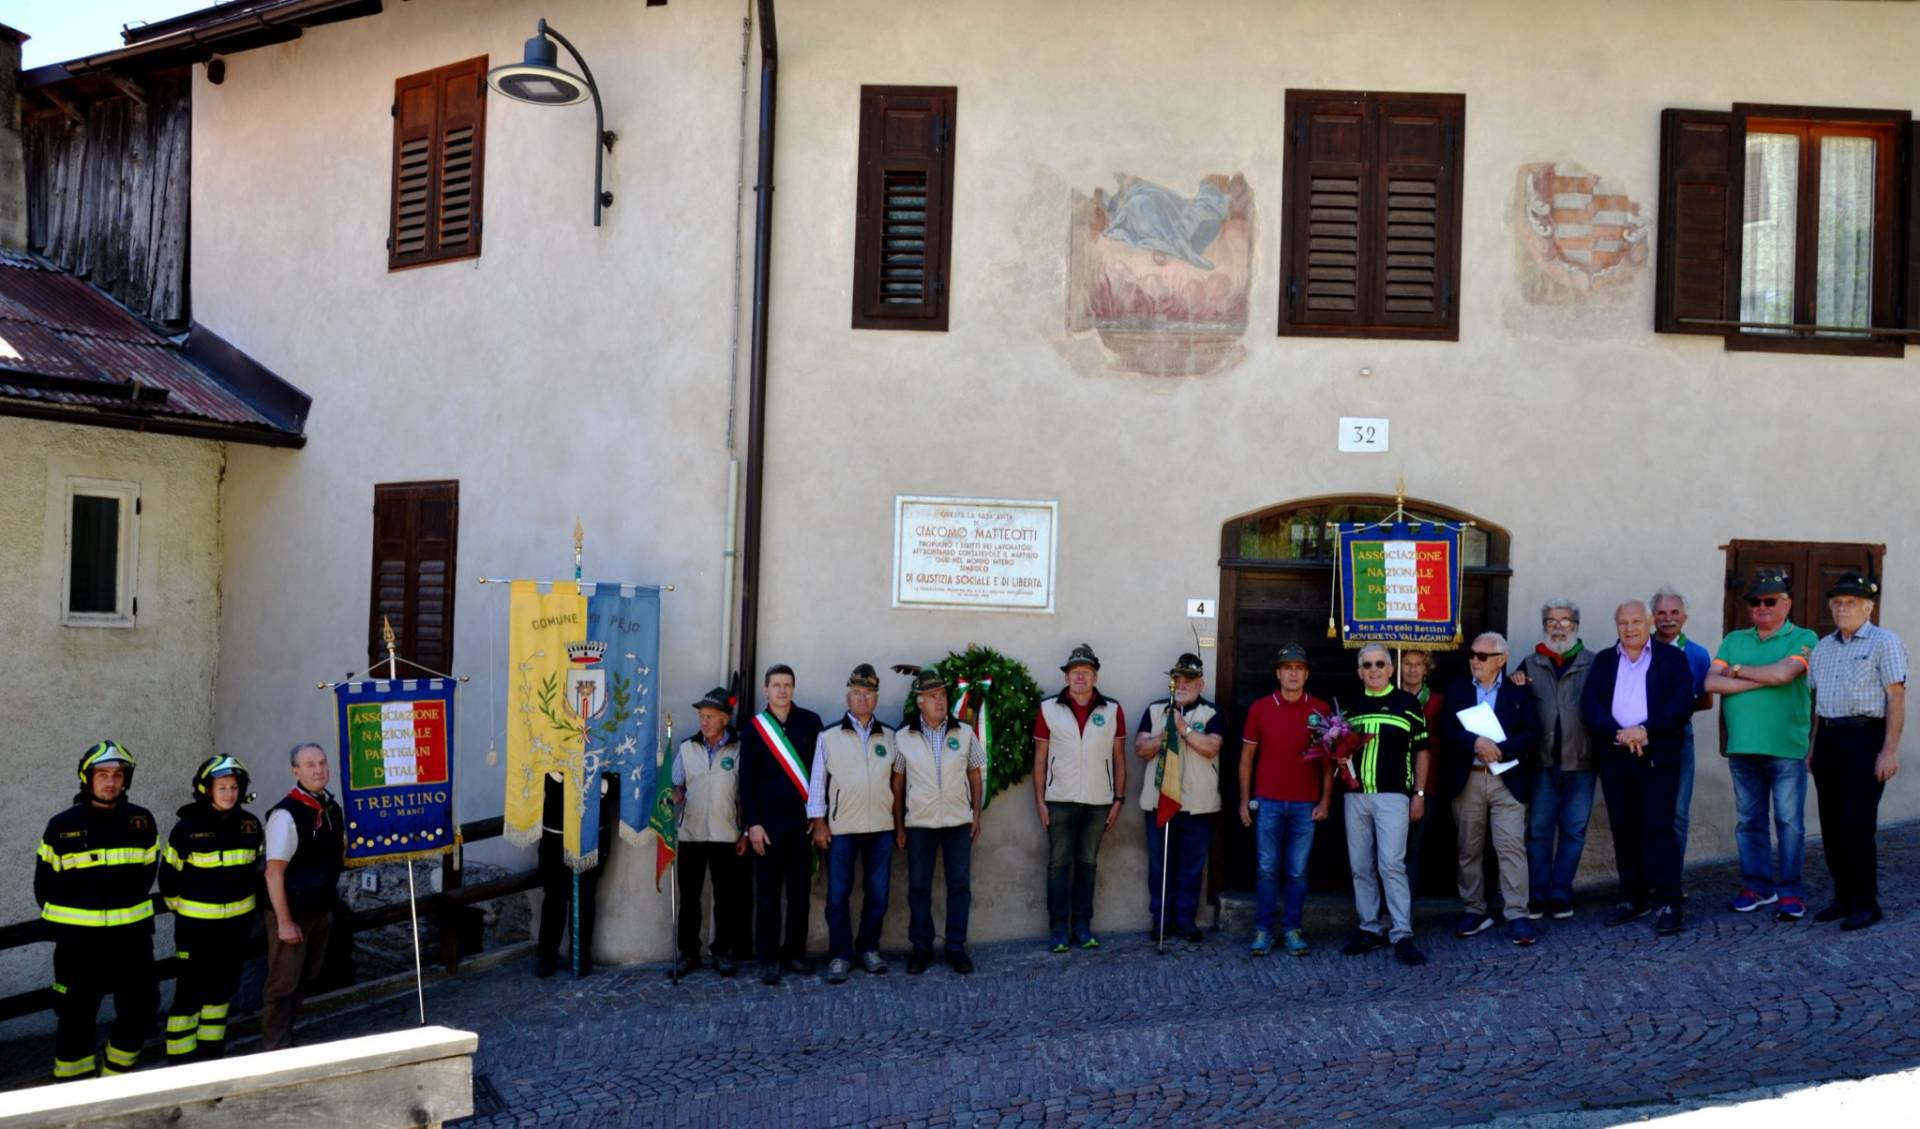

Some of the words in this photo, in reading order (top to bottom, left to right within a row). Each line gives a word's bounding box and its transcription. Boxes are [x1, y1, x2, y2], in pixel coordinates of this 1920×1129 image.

[1353, 426, 1376, 444] 32
[975, 528, 1038, 541] MATTEOTTI
[1358, 551, 1442, 561] ASSOCIAZIONE
[1367, 568, 1434, 578] NAZIONALE
[906, 574, 913, 583] DI
[916, 574, 953, 584] GIUSTIZIA
[955, 576, 991, 585] SOCIALE
[994, 577, 998, 586] E
[1002, 577, 1009, 586] DI
[1368, 585, 1431, 594] PARTIGIANI
[1197, 602, 1205, 615] 4
[1377, 602, 1426, 612] D'ITALIA
[531, 613, 578, 630] COMUNE
[610, 616, 640, 633] PEJO
[354, 709, 439, 724] ASSOCIAZIONE
[362, 728, 432, 741] NAZIONALE
[365, 746, 430, 760] PARTIGIANI
[374, 765, 425, 778] D'ITALIA
[354, 792, 447, 810] TRENTINO
[367, 877, 371, 887] 6
